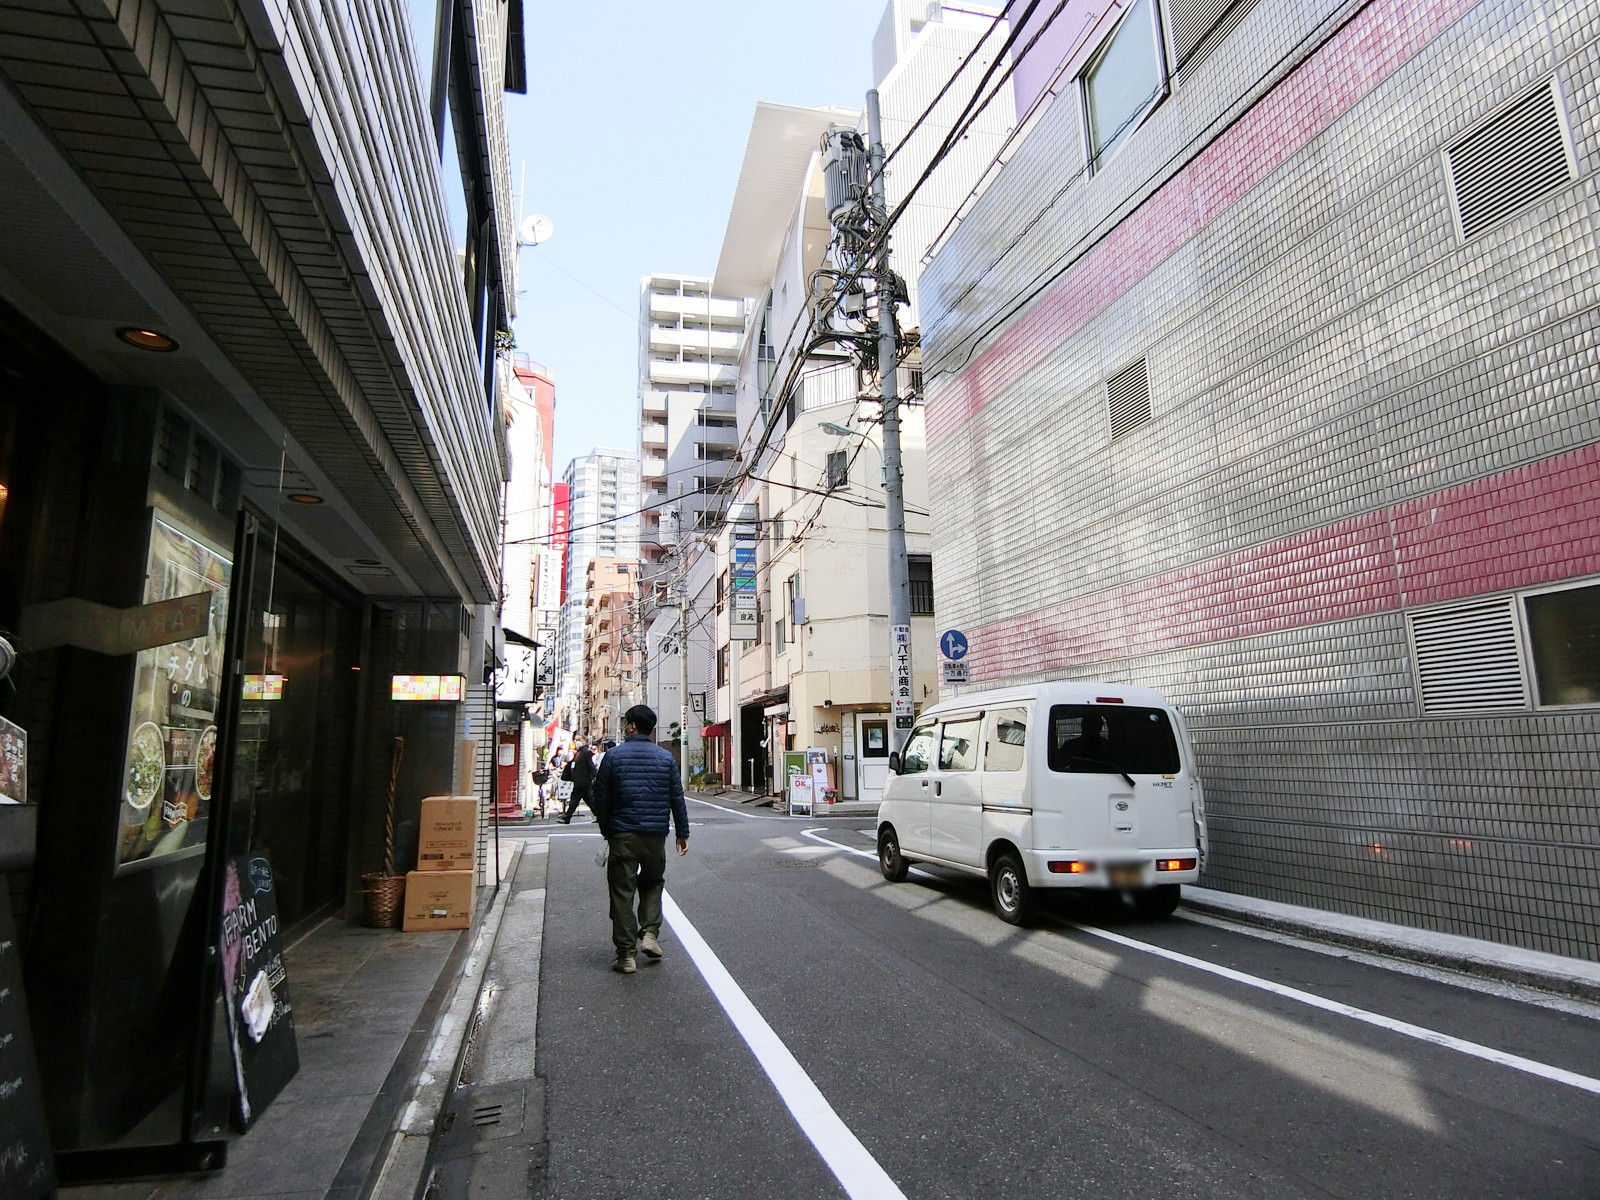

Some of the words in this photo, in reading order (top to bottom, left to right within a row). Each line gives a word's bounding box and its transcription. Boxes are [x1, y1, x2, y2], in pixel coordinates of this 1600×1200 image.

[399, 682, 433, 693] FARM
[443, 682, 457, 693] TO
[223, 898, 257, 946] FARM
[244, 914, 278, 960] BENTO
